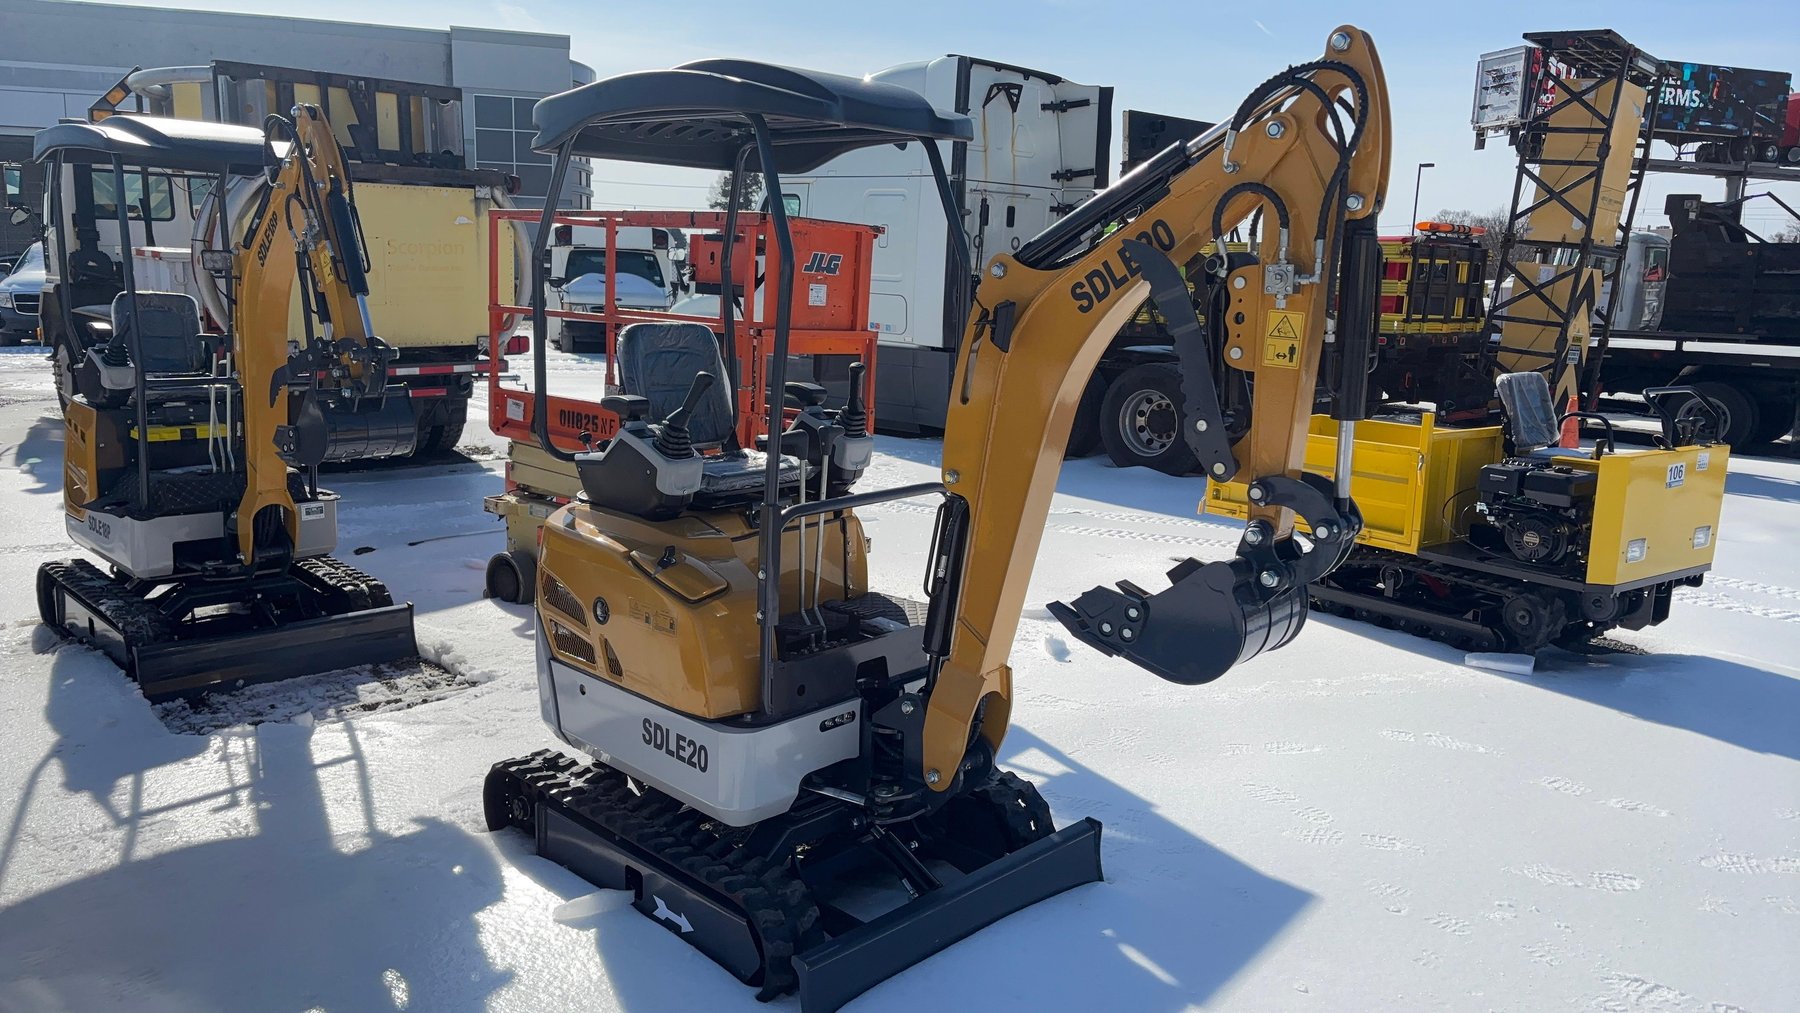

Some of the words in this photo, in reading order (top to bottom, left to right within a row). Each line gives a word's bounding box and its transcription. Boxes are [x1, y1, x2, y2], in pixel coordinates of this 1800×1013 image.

[387, 239, 465, 260] Scorpion
[802, 251, 844, 276] JLG
[1668, 464, 1684, 481] 106
[641, 717, 709, 773] SDLE20
